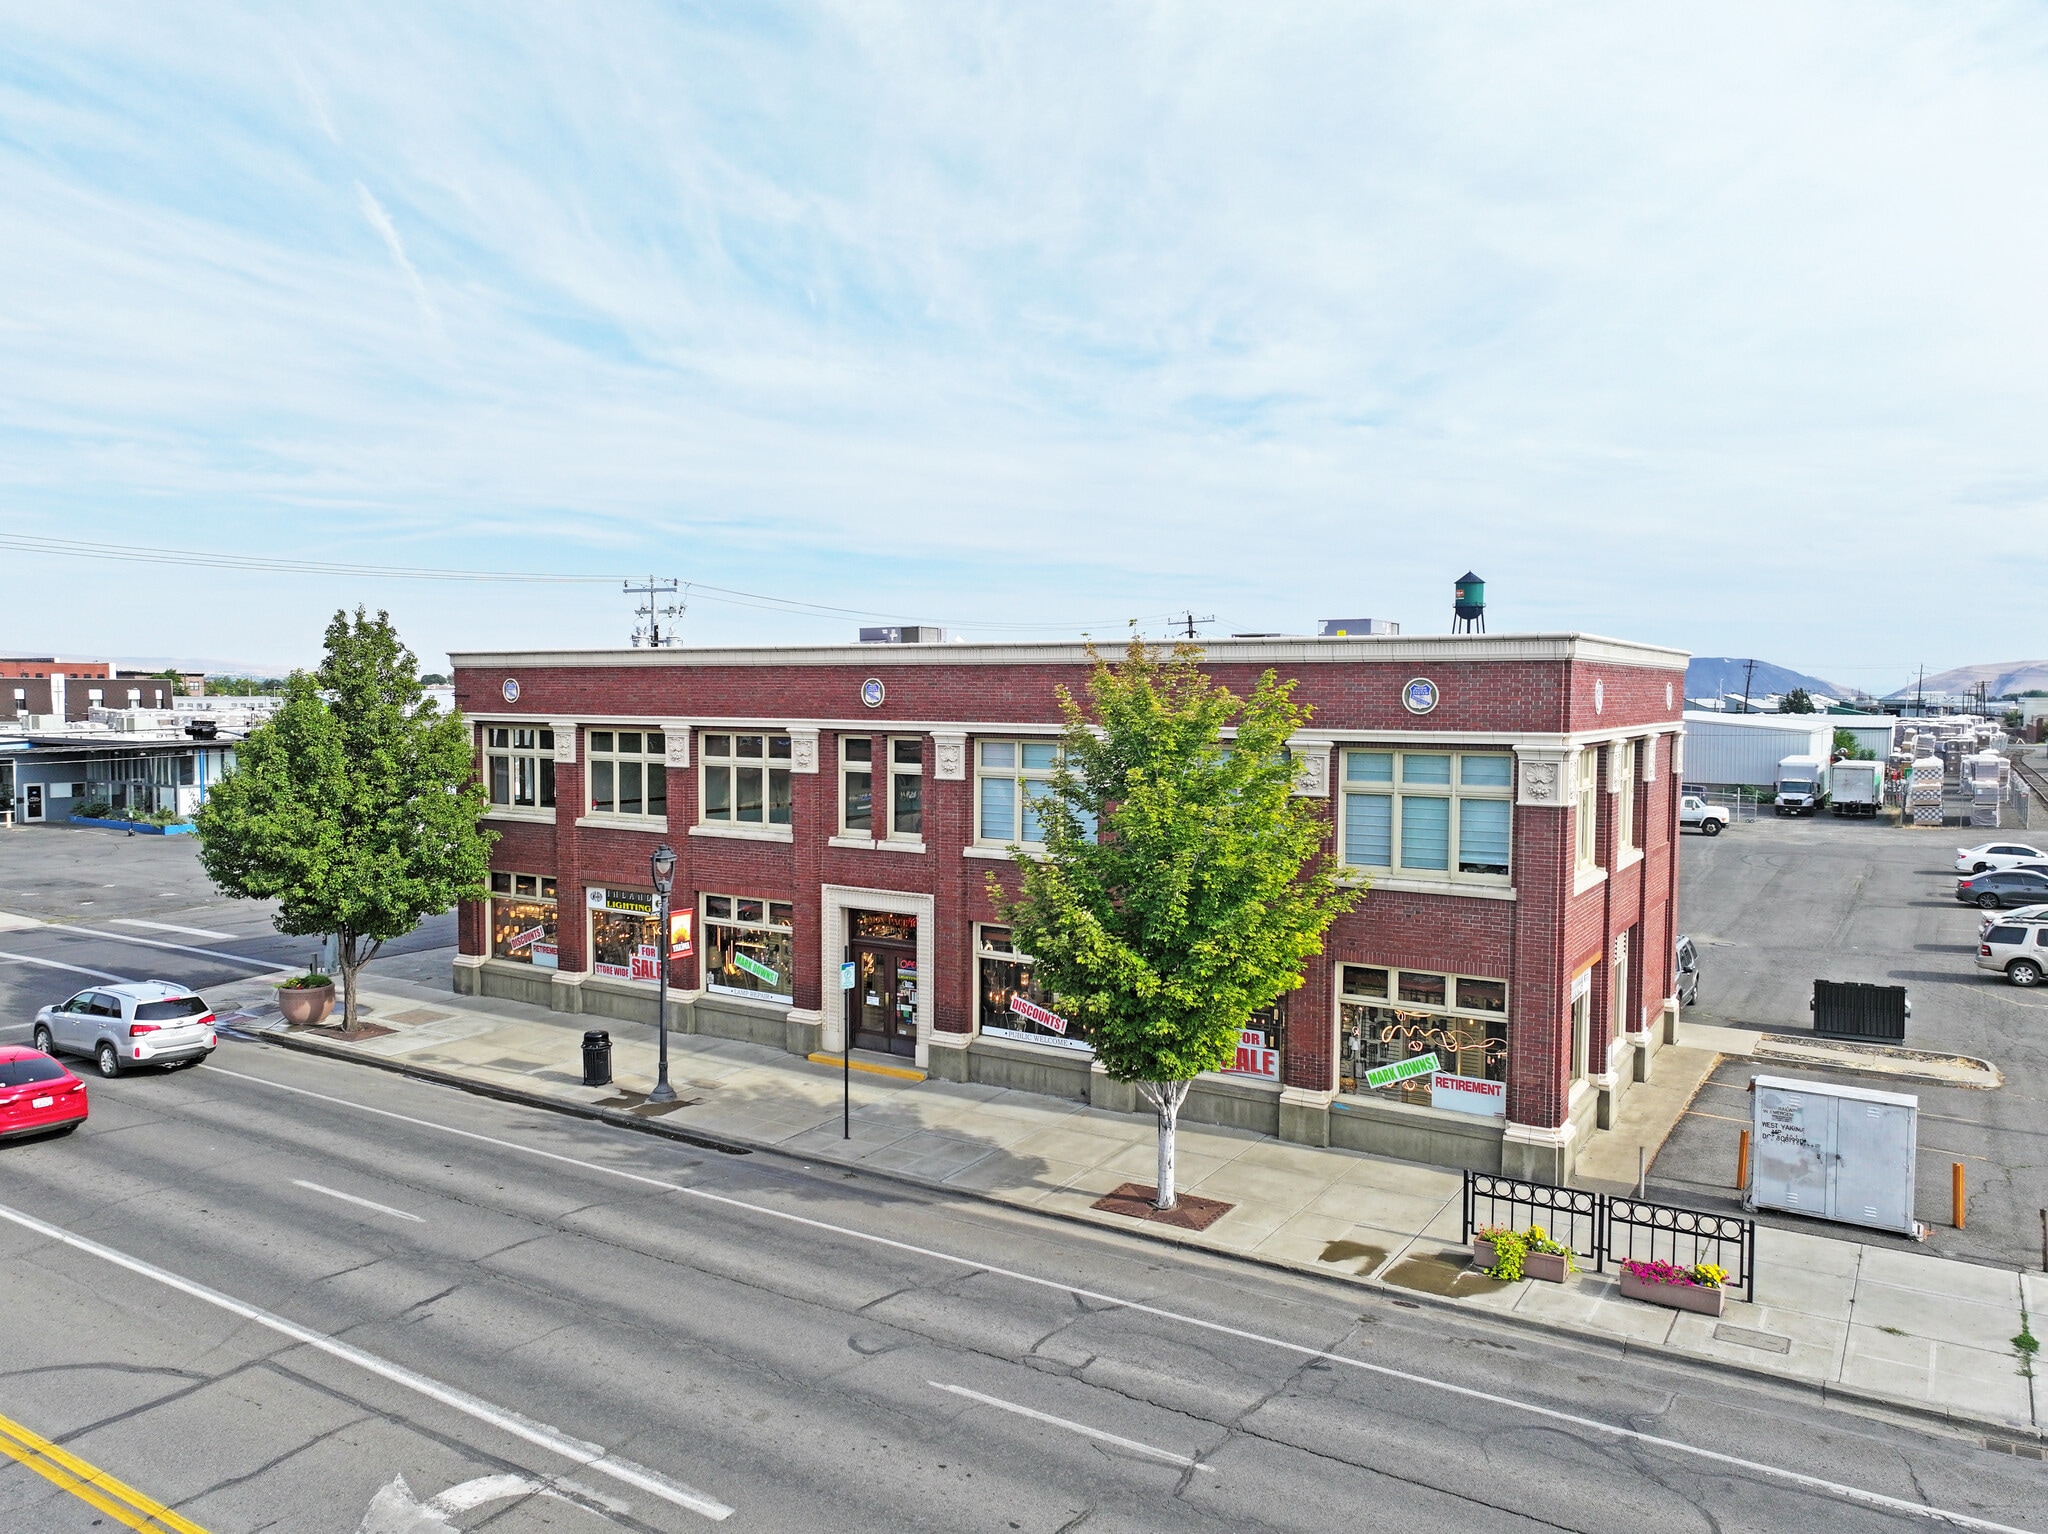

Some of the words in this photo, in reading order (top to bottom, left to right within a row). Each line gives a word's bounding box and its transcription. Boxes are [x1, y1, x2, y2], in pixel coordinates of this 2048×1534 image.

[607, 890, 652, 901] INLAND
[607, 901, 651, 912] LIGHTING
[511, 927, 544, 949] DISCOUNTS!
[533, 945, 558, 956] RETIREME
[641, 947, 656, 957] FOR
[596, 964, 613, 975] STORE
[614, 966, 629, 977] WIDE
[736, 954, 752, 972] MARK
[752, 962, 778, 984] DOWNS!
[900, 959, 917, 969] OPE
[750, 991, 770, 999] REPAIR
[1012, 998, 1066, 1032] DISCOUNTS!
[1008, 1031, 1032, 1041] PUBLIC
[1033, 1035, 1068, 1046] WELCOME
[1242, 1032, 1260, 1045] OR
[1221, 1047, 1275, 1076] ALE
[1368, 1068, 1398, 1086] MARK
[1396, 1055, 1439, 1077] DOWNS!
[1435, 1076, 1502, 1096] RETIREMENT
[1762, 1121, 1779, 1129] WEST
